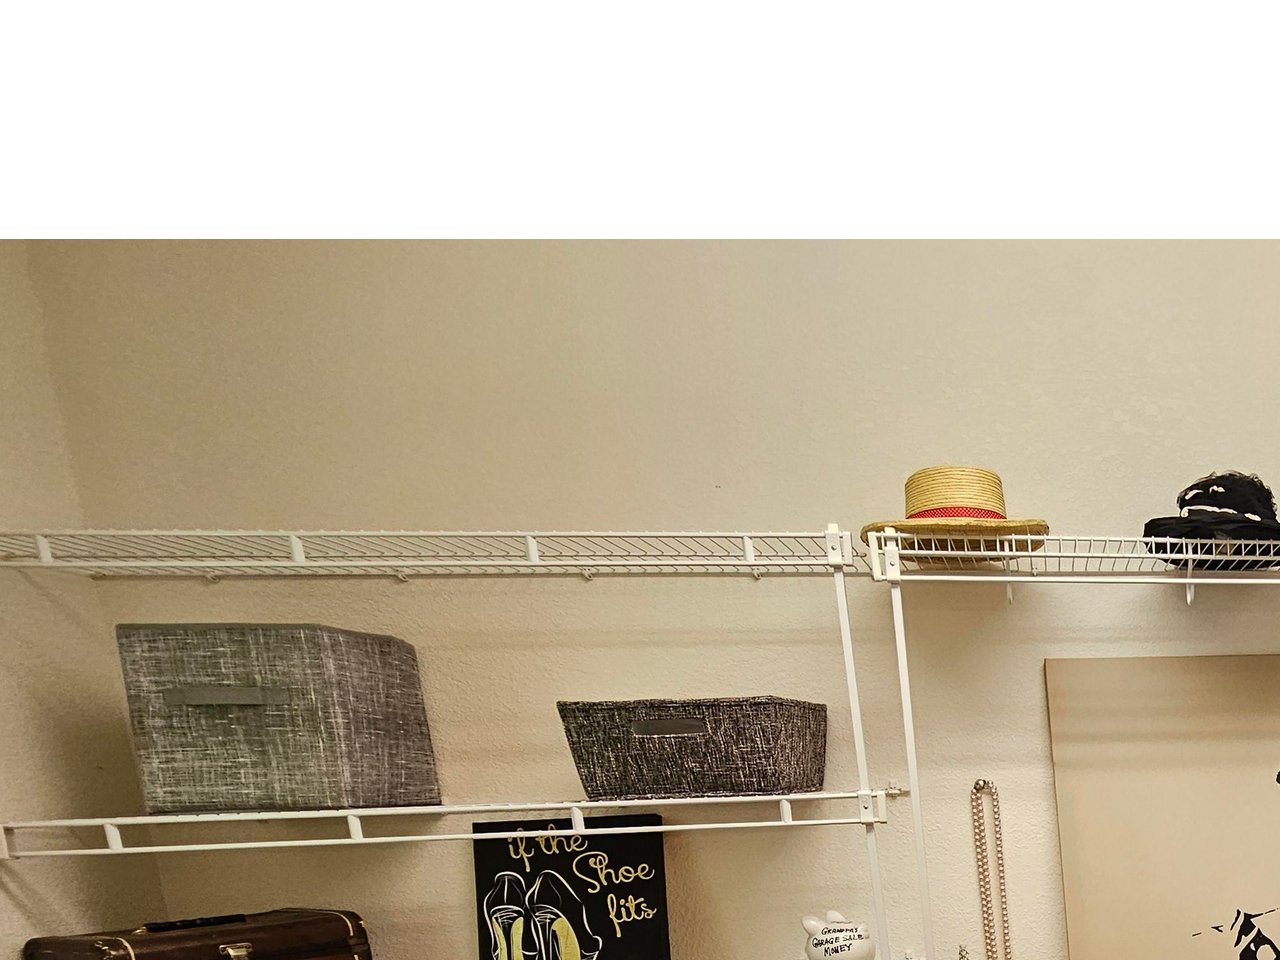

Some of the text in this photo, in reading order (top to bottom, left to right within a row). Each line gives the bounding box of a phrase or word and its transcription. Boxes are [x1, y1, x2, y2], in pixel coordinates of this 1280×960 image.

[507, 823, 588, 873] if the
[572, 851, 655, 894] Shoe
[606, 893, 657, 938] fits
[812, 934, 864, 949] GARAGE SALE
[823, 943, 852, 957] MONEY
